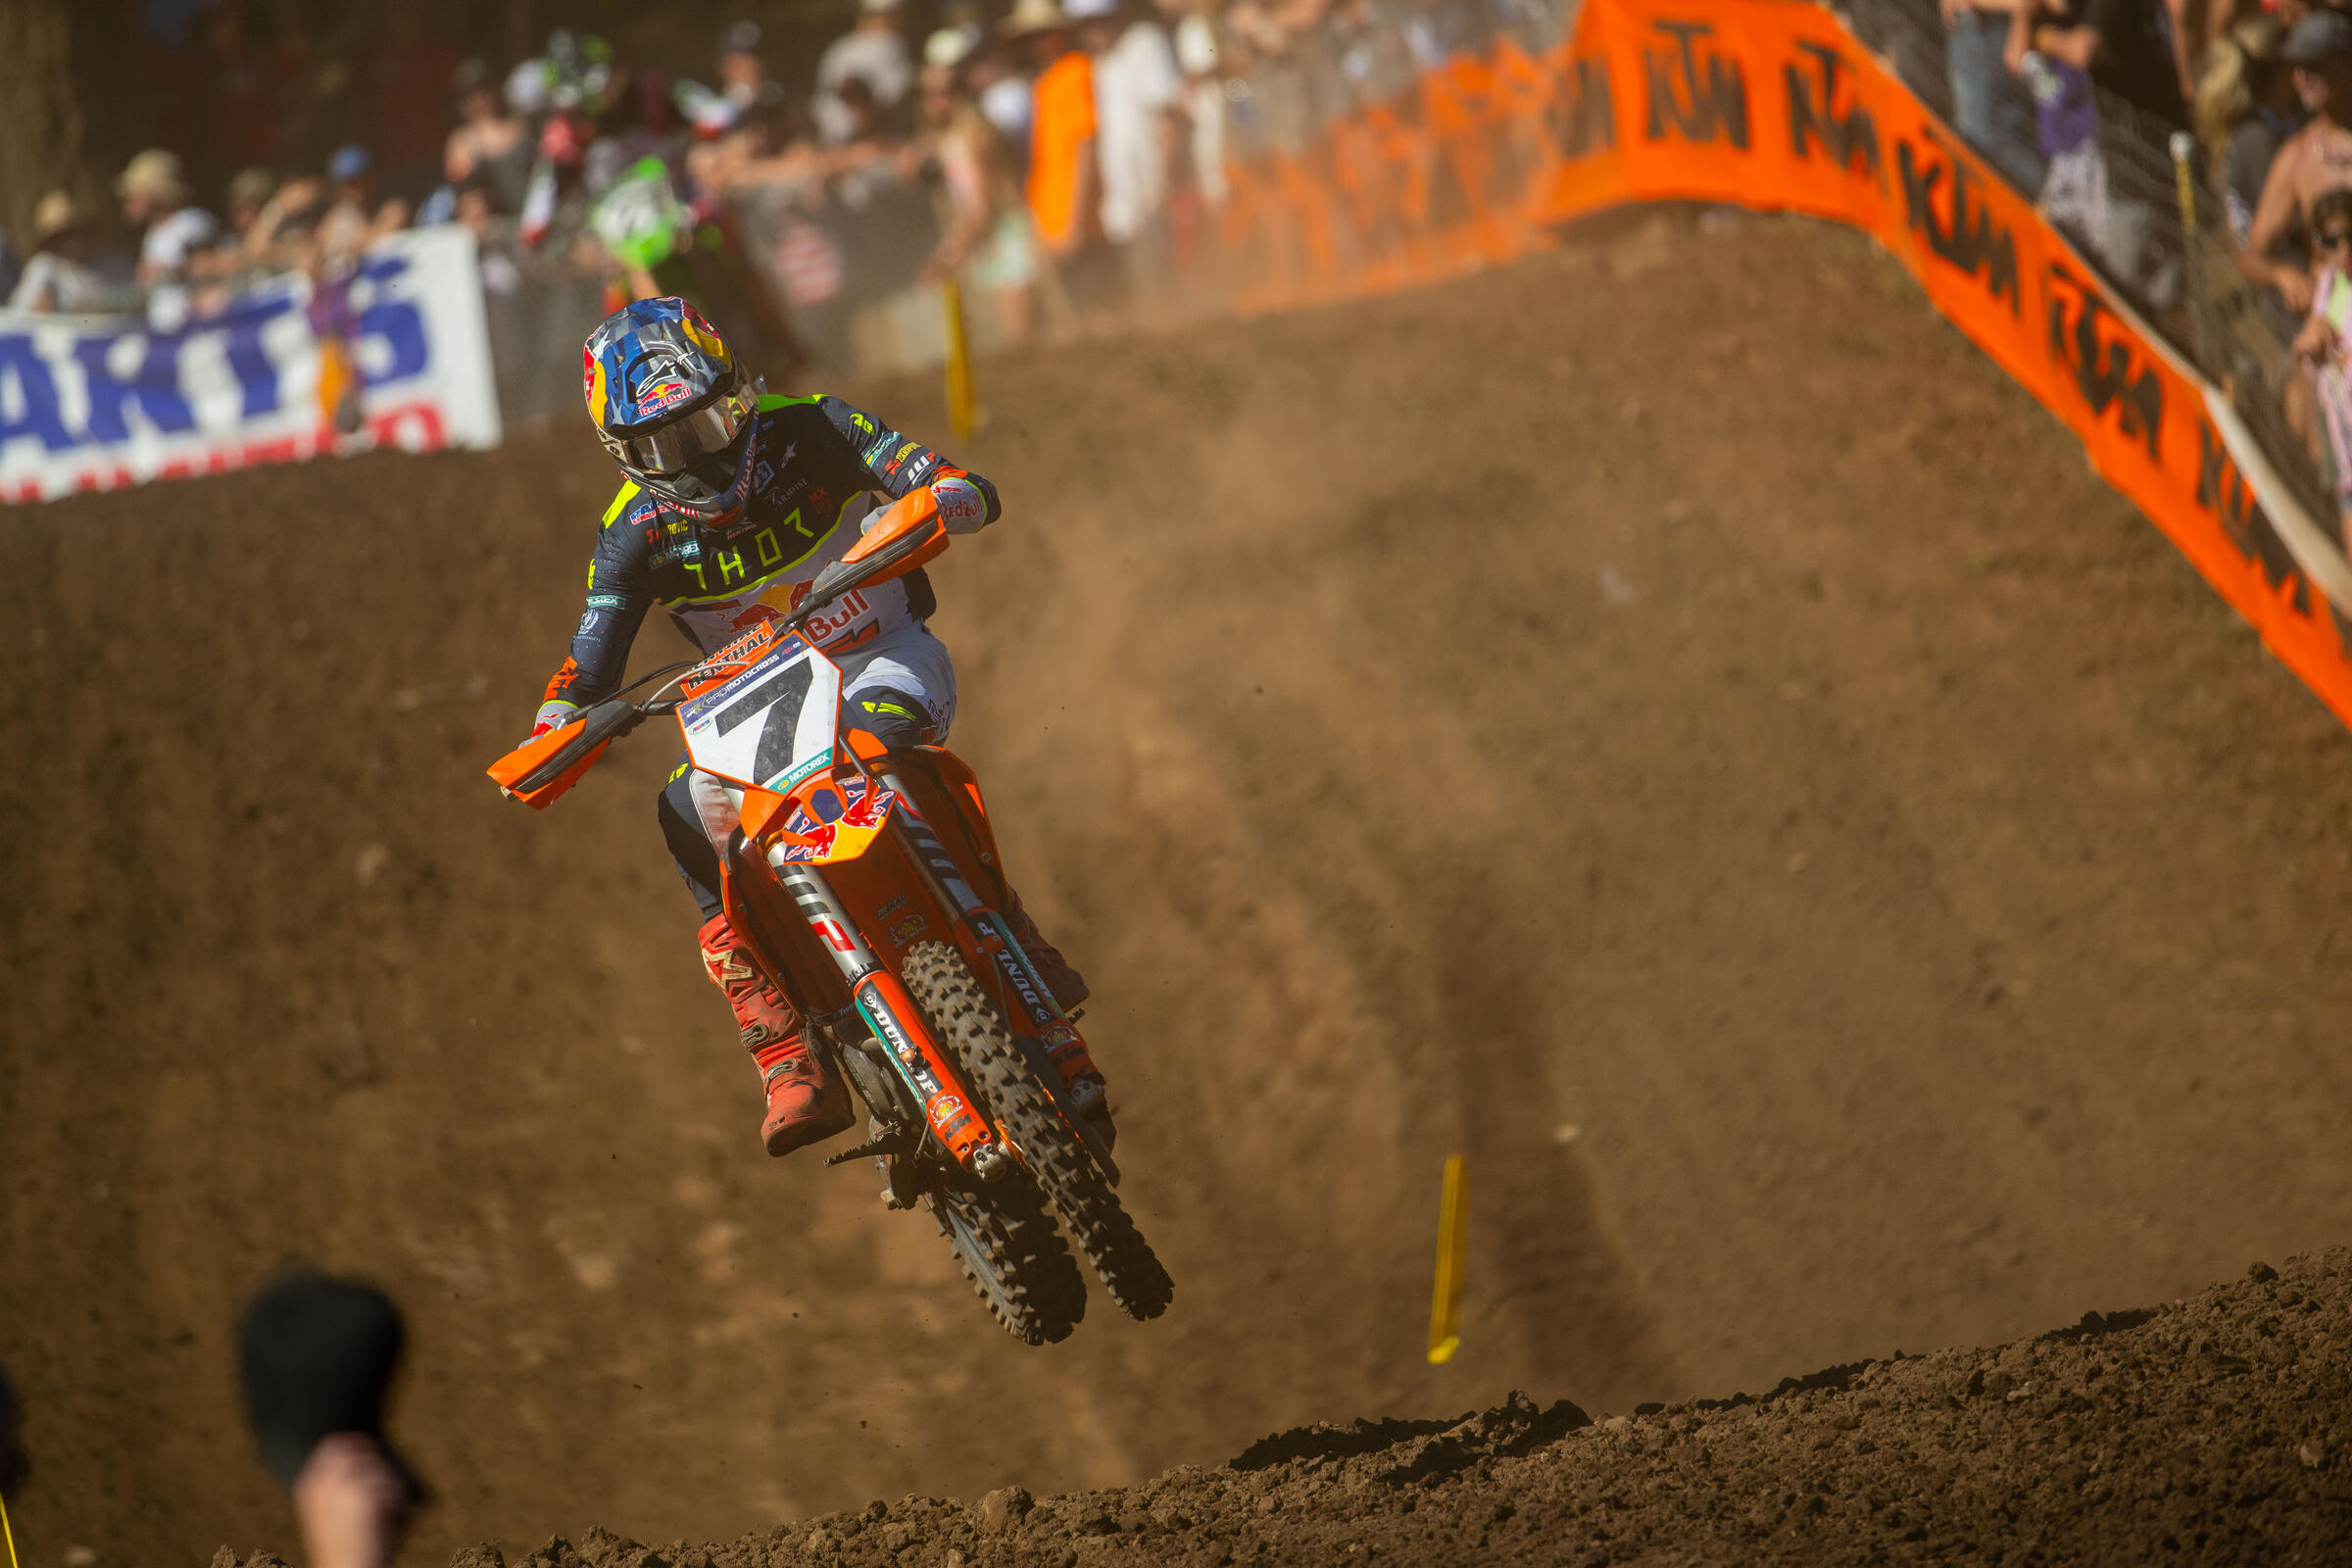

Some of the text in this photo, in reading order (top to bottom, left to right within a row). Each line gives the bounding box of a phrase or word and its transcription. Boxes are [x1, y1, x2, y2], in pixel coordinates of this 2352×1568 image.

[1644, 20, 1750, 150] KTM
[639, 387, 692, 417] Red Bull
[683, 506, 815, 591] THOR
[804, 587, 870, 643] Bull
[688, 631, 771, 691] RENTHAL
[714, 656, 814, 785] 7
[789, 753, 831, 783] MOTOREX
[978, 921, 1042, 1005] DUNLP
[944, 1113, 973, 1142] KTM
